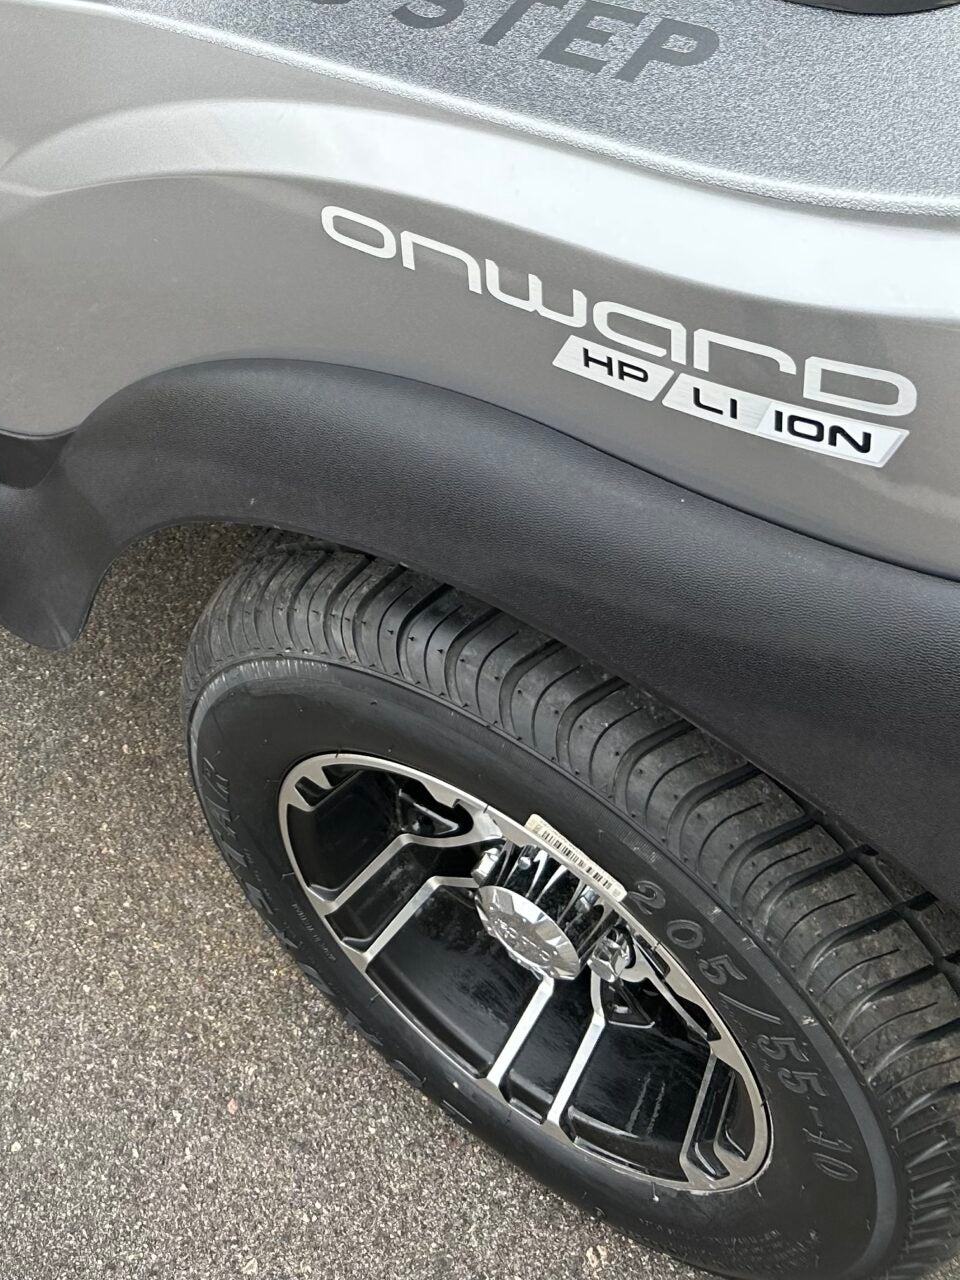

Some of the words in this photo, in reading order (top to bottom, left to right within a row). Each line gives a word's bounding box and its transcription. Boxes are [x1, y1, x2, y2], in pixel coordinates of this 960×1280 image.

[582, 346, 650, 384] HP
[692, 386, 739, 420] LI
[773, 408, 873, 455] ION
